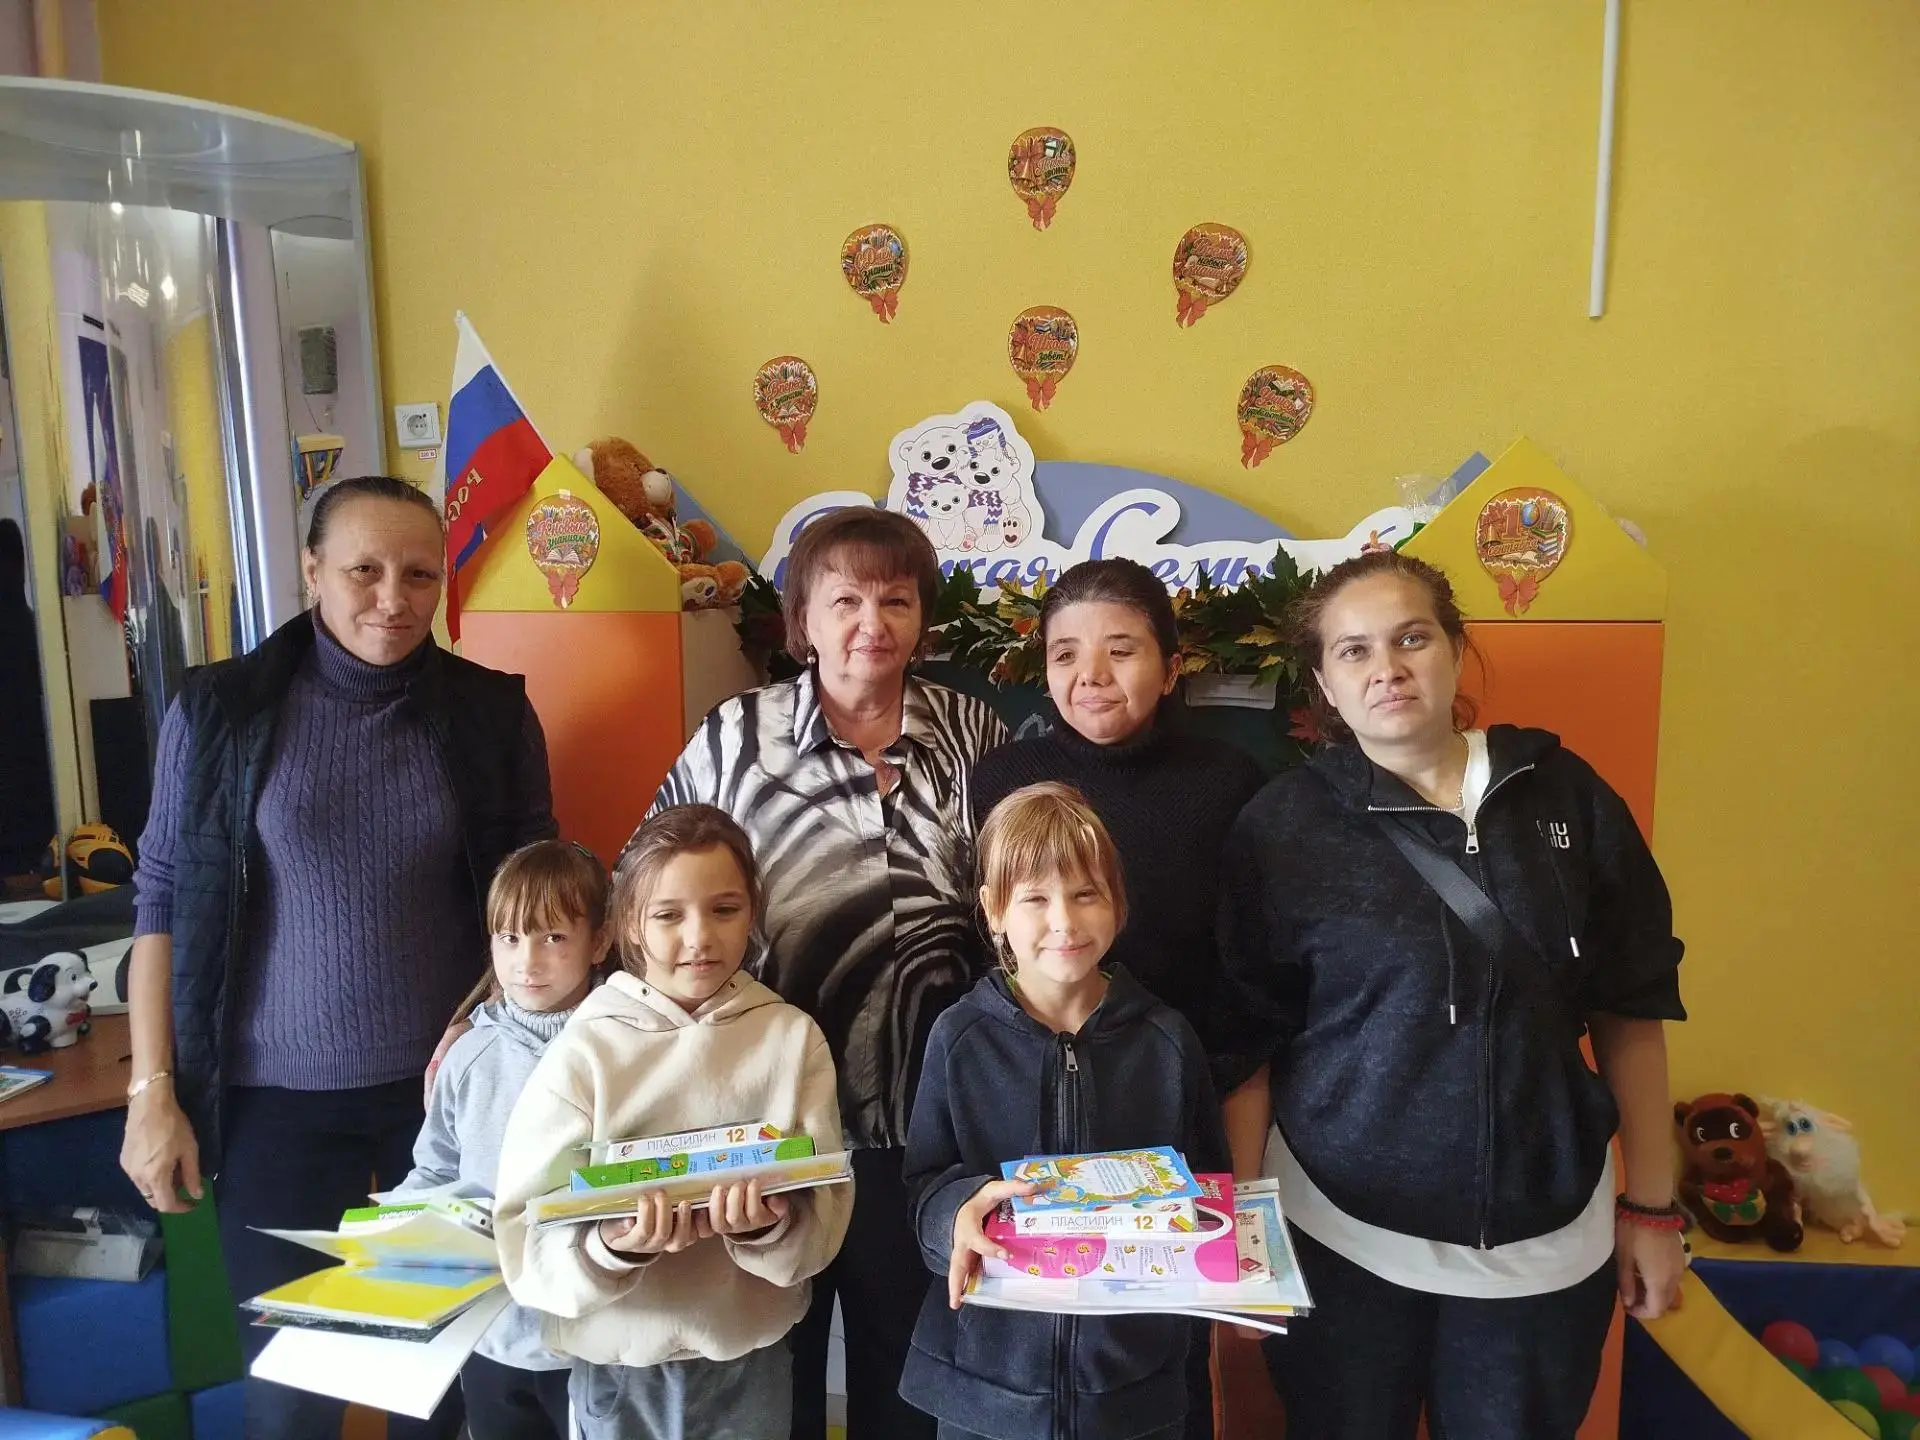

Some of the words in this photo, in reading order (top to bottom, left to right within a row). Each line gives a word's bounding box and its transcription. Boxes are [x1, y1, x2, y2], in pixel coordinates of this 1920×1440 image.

[1503, 503, 1522, 540] 1
[647, 1132, 716, 1150] ПЛАСТИЛИН
[726, 1128, 745, 1143] 12
[1050, 1216, 1123, 1227] ПЛАСТИЛИН
[1134, 1215, 1154, 1230] 12
